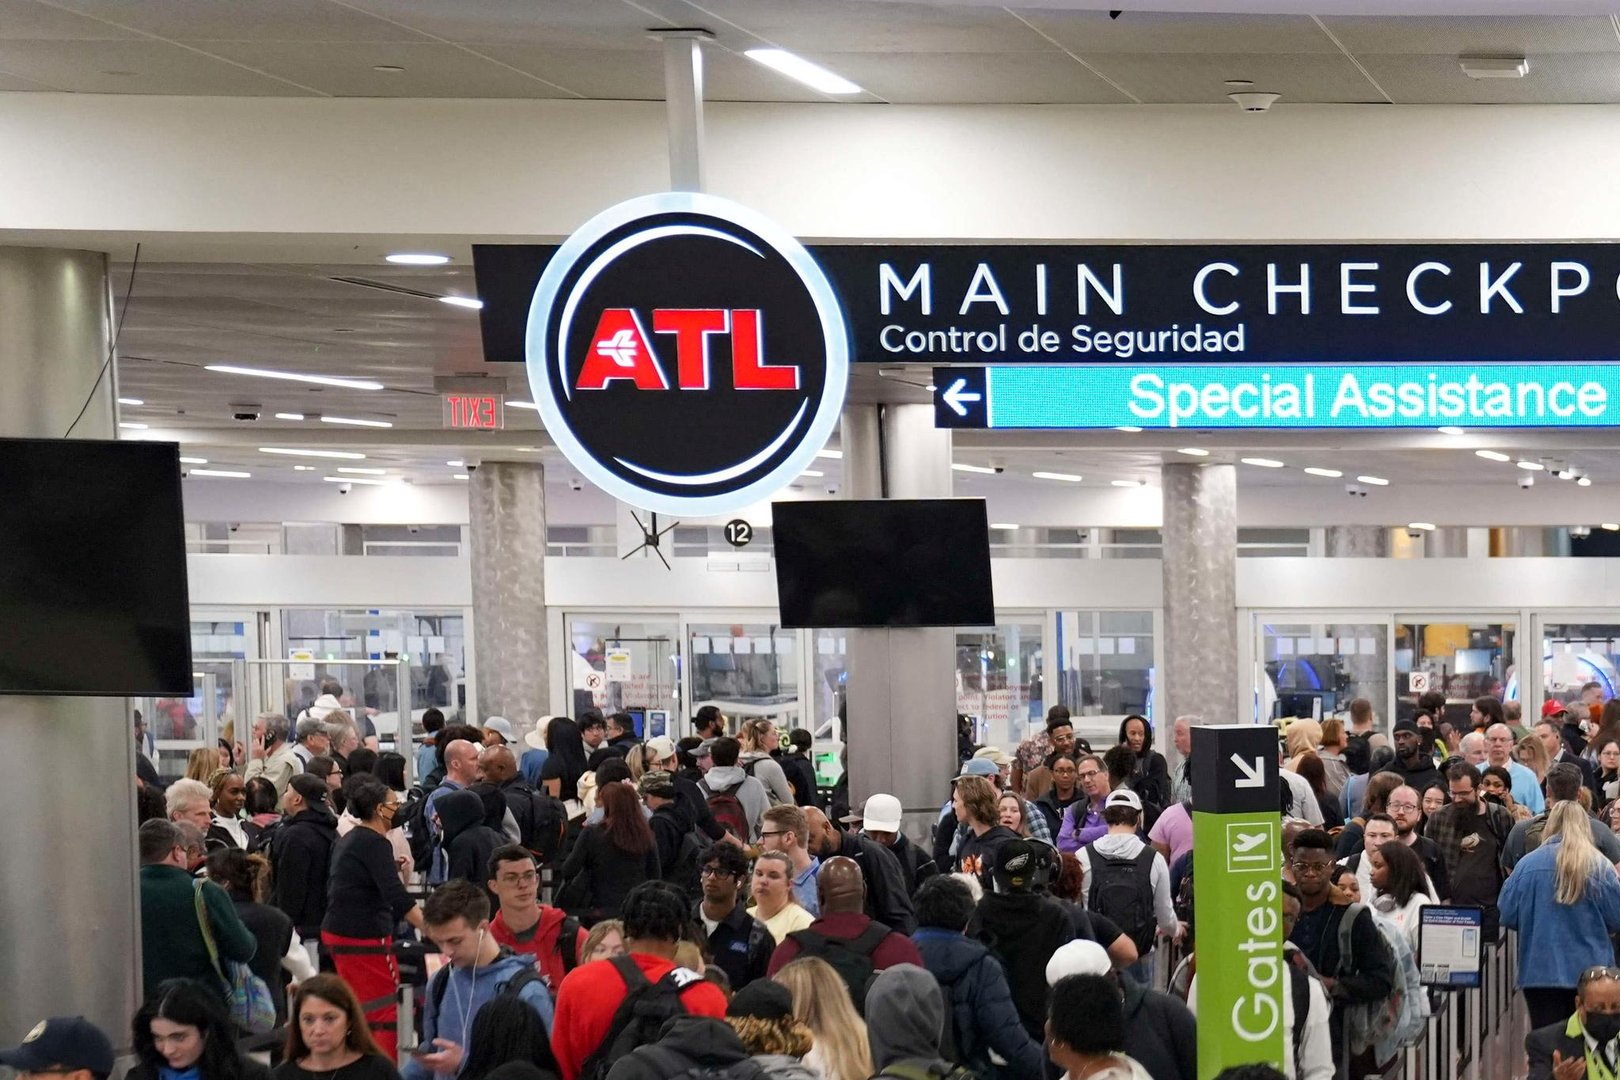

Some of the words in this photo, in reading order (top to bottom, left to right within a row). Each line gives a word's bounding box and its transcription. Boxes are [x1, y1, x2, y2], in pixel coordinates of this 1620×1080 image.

[879, 263, 1123, 316] MAIN
[575, 308, 799, 390] ATL
[879, 324, 1006, 353] Control
[1018, 324, 1060, 353] de
[1071, 323, 1245, 358] Seguridad
[1128, 372, 1314, 427] Special
[1330, 372, 1607, 418] Assistance
[727, 522, 749, 543] 12
[1231, 881, 1279, 1043] Gates
